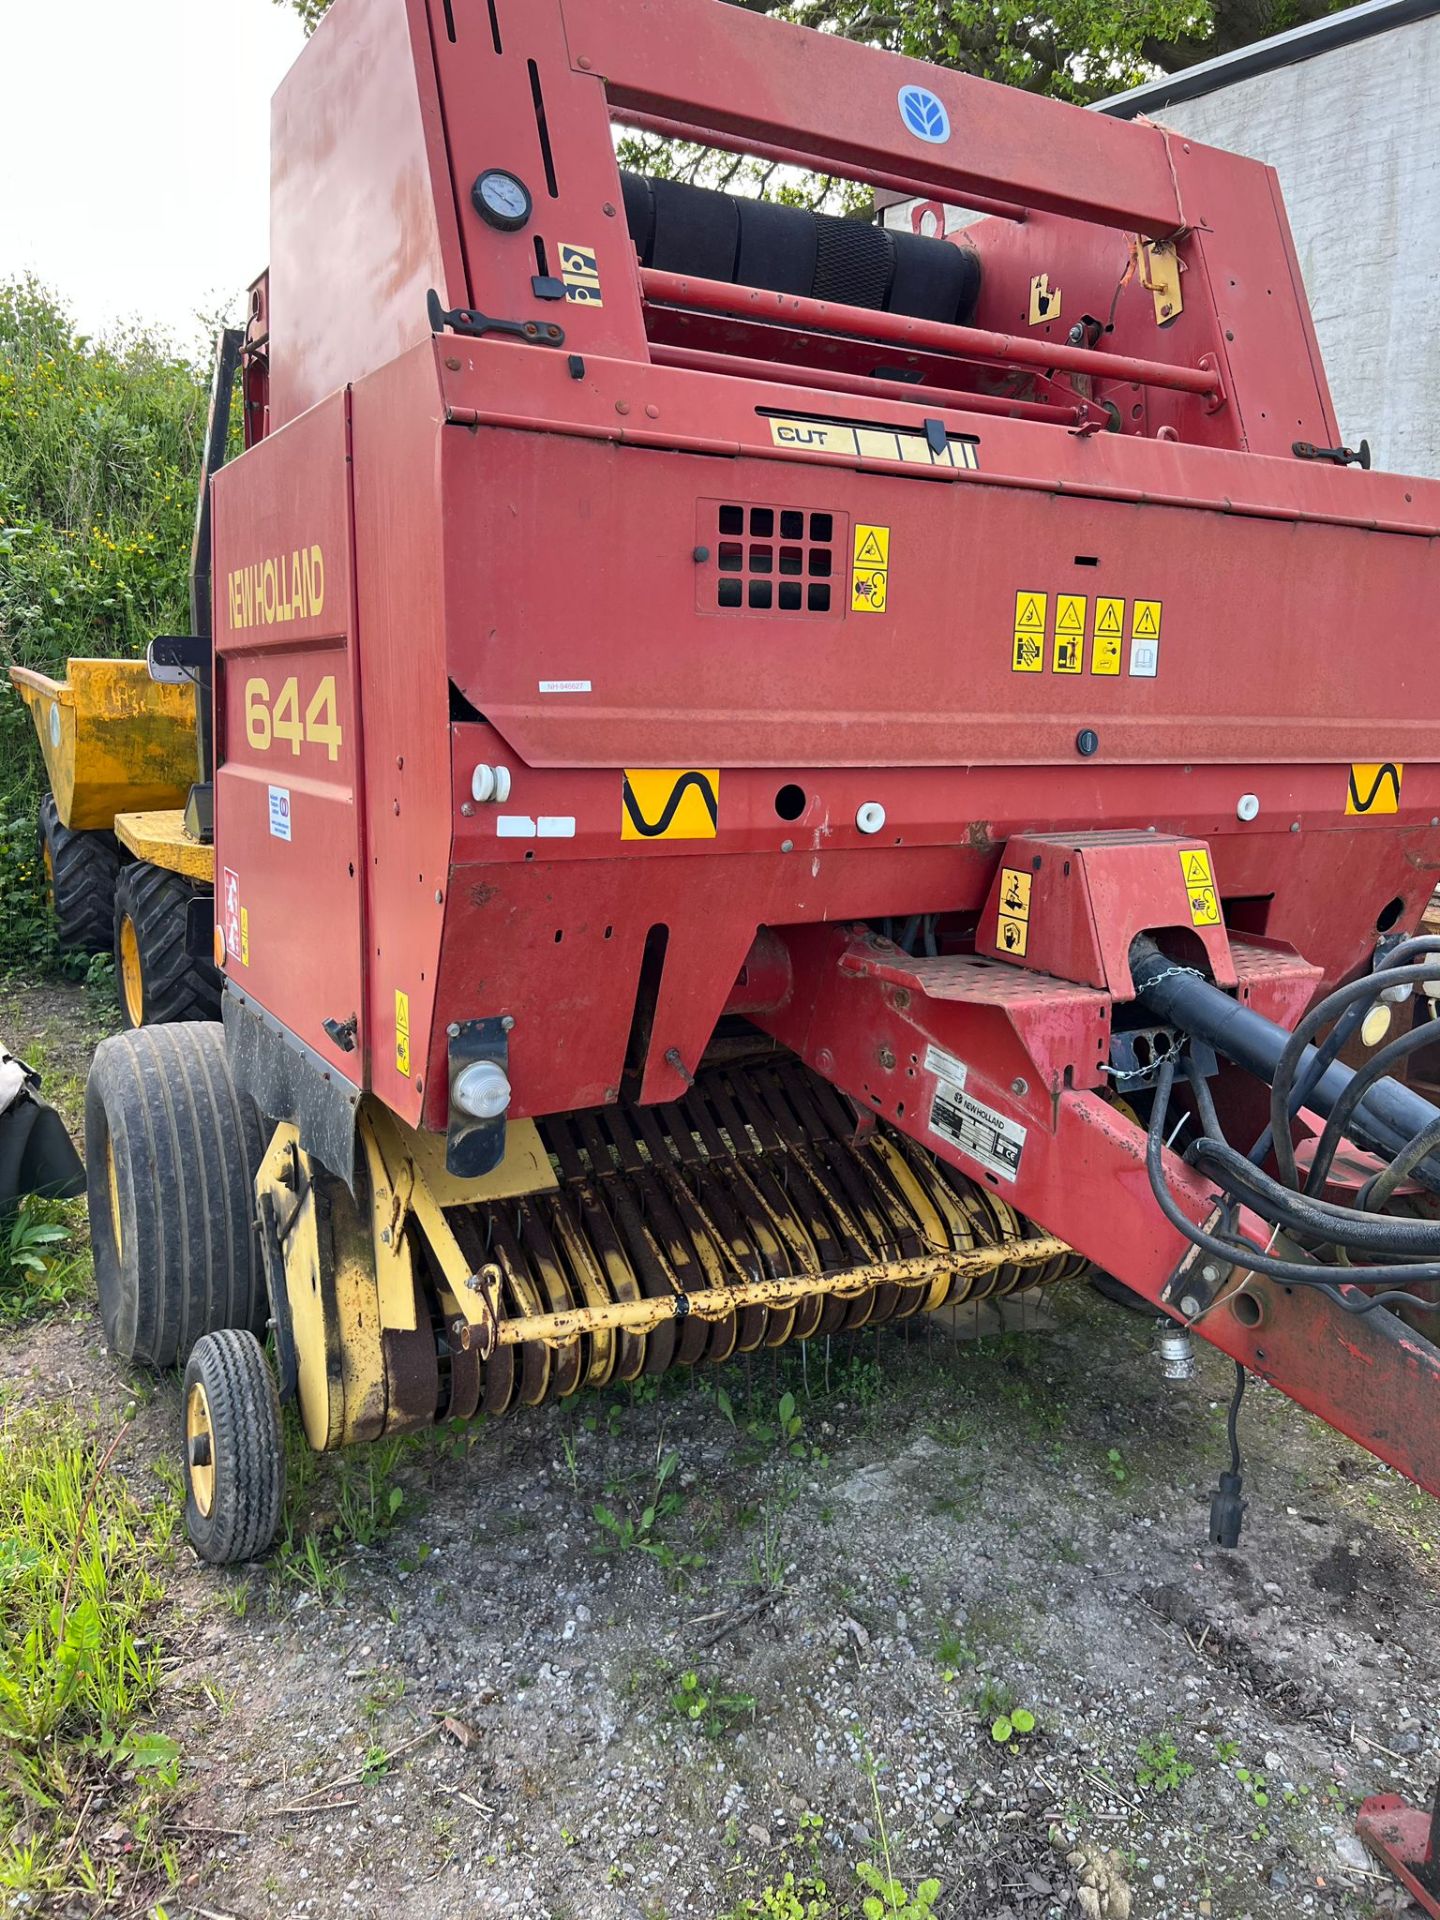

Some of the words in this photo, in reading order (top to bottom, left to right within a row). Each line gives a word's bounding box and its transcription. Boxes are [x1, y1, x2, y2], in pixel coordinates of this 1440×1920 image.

[777, 426, 828, 445] CUT
[228, 565, 253, 630] NEW
[254, 544, 325, 625] HOLLAND
[245, 675, 342, 762] 644
[963, 1100, 977, 1113] NEW
[977, 1108, 1005, 1130] HOLLAND
